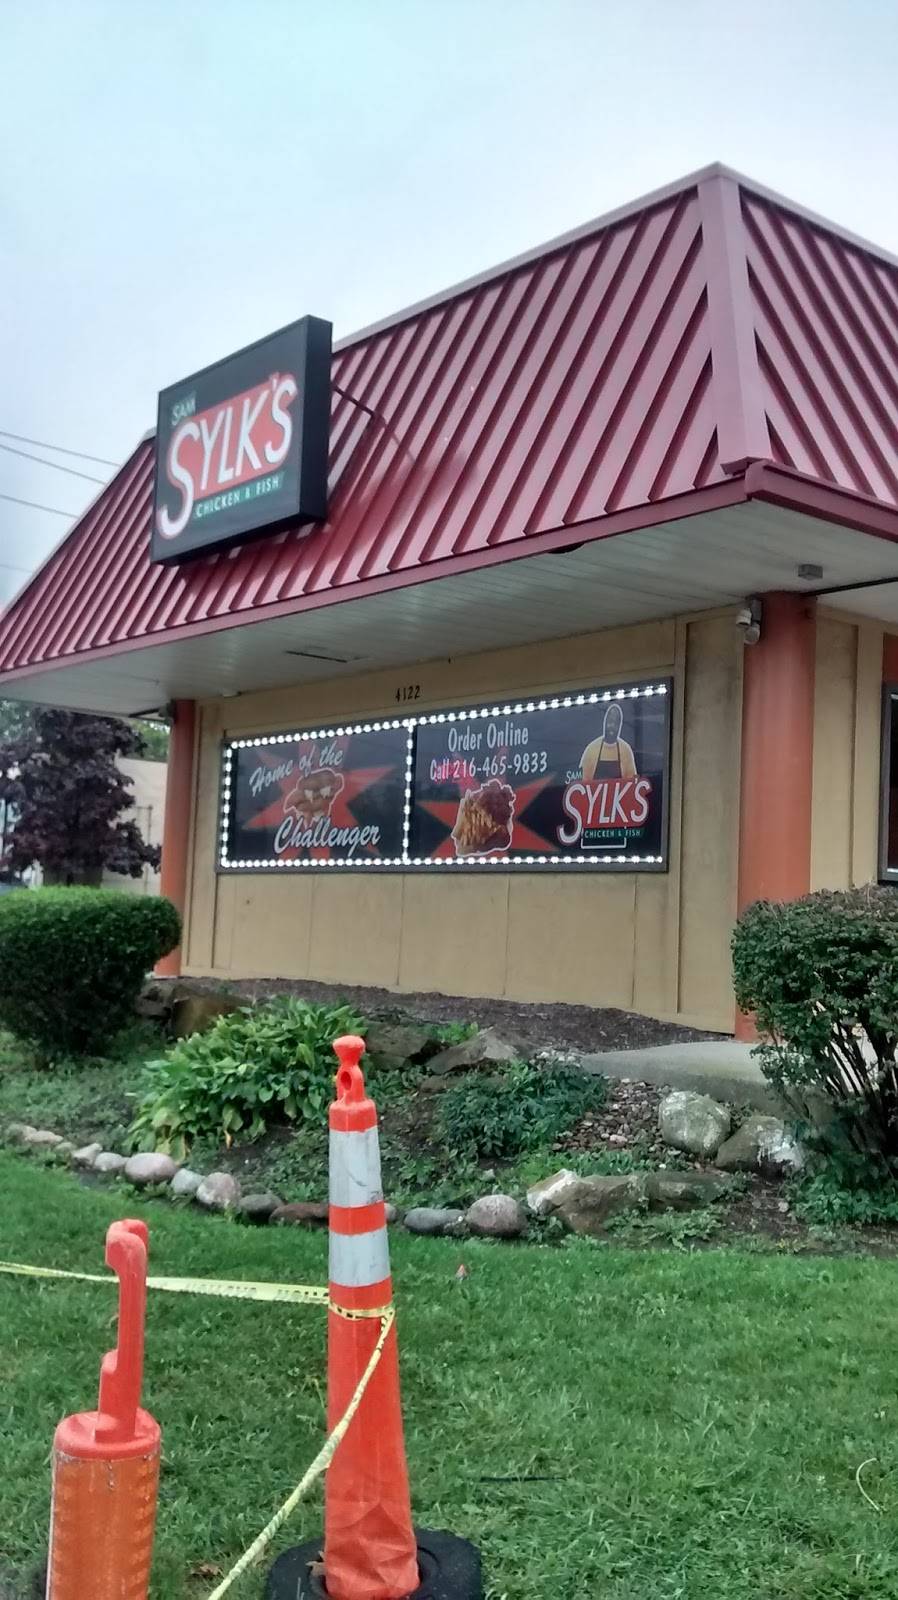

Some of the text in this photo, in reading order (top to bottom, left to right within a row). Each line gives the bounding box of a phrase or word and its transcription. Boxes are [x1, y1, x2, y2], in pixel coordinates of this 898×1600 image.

[171, 393, 196, 426] SAM
[158, 377, 297, 537] SYLK'S
[196, 490, 240, 517] CHICKEN
[256, 476, 280, 495] FISH
[395, 685, 421, 702] 4122
[448, 721, 529, 752] Order Online
[249, 740, 344, 797] Home of the
[430, 751, 548, 781] Call 216-465-9833
[565, 770, 582, 784] SAM
[559, 778, 651, 844] SYLK'S
[274, 815, 381, 857] Challenger
[584, 829, 614, 838] CHICKEN
[625, 829, 640, 837] FISH
